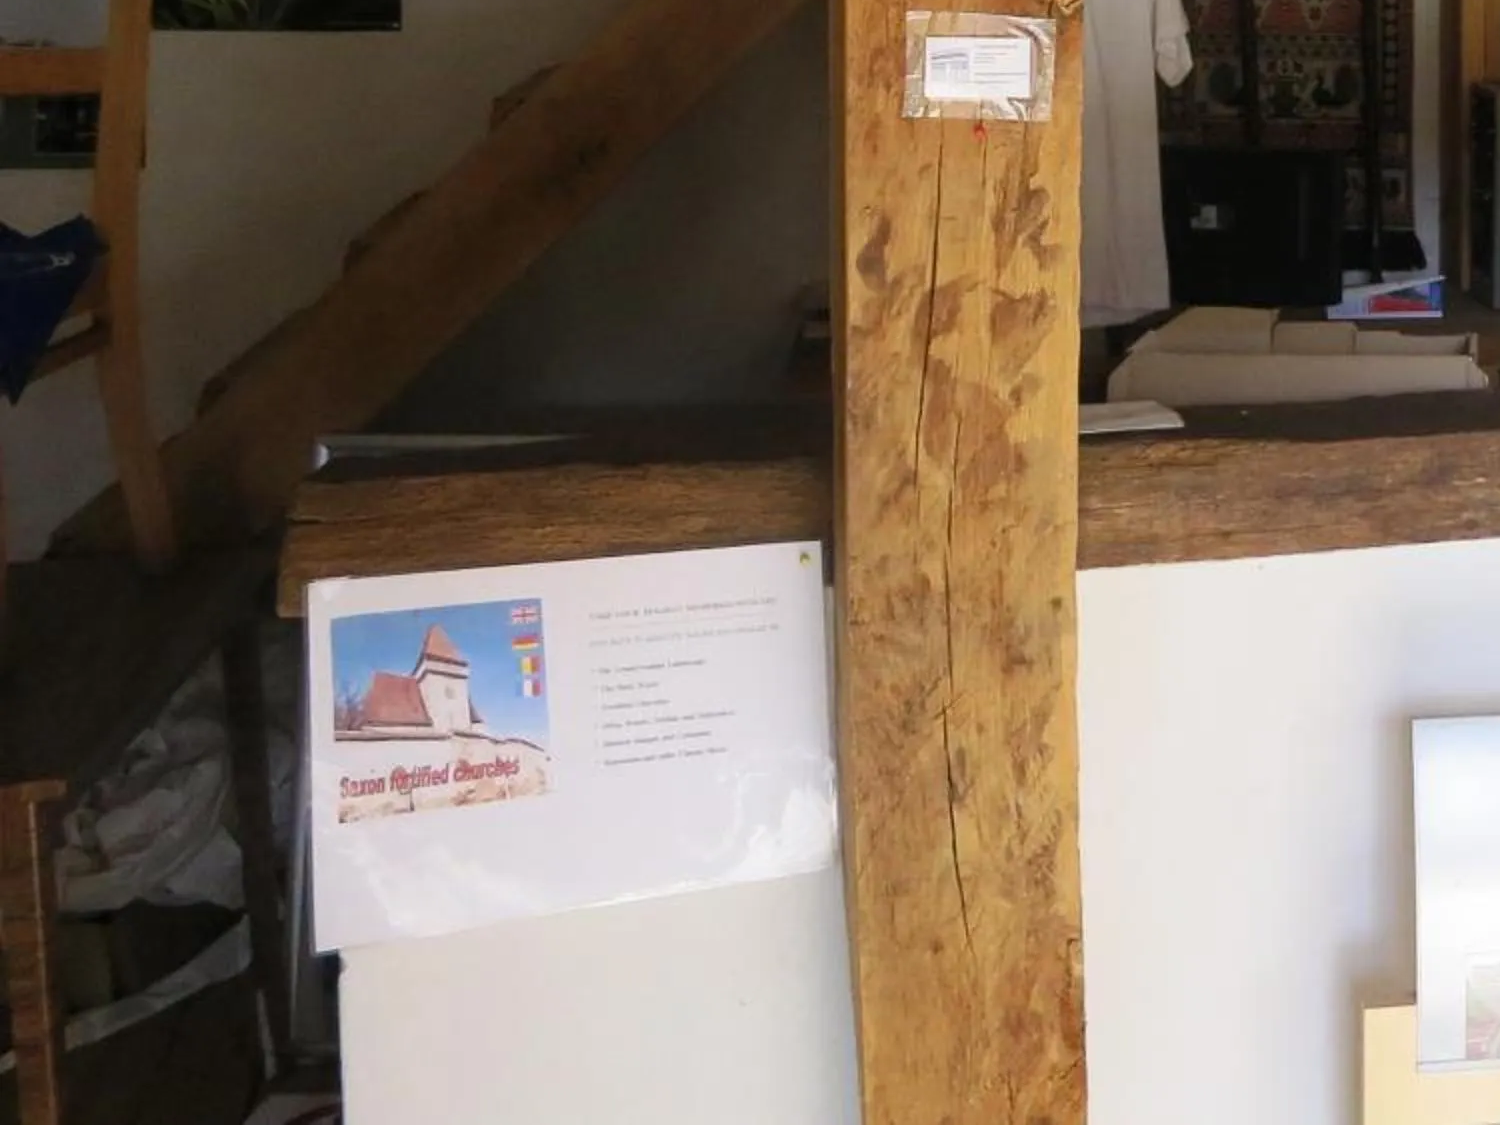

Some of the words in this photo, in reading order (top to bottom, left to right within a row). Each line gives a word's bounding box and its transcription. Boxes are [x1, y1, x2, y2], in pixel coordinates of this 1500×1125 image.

[339, 775, 386, 798] Saxon
[389, 763, 450, 792] fortified
[453, 756, 521, 783] churches
